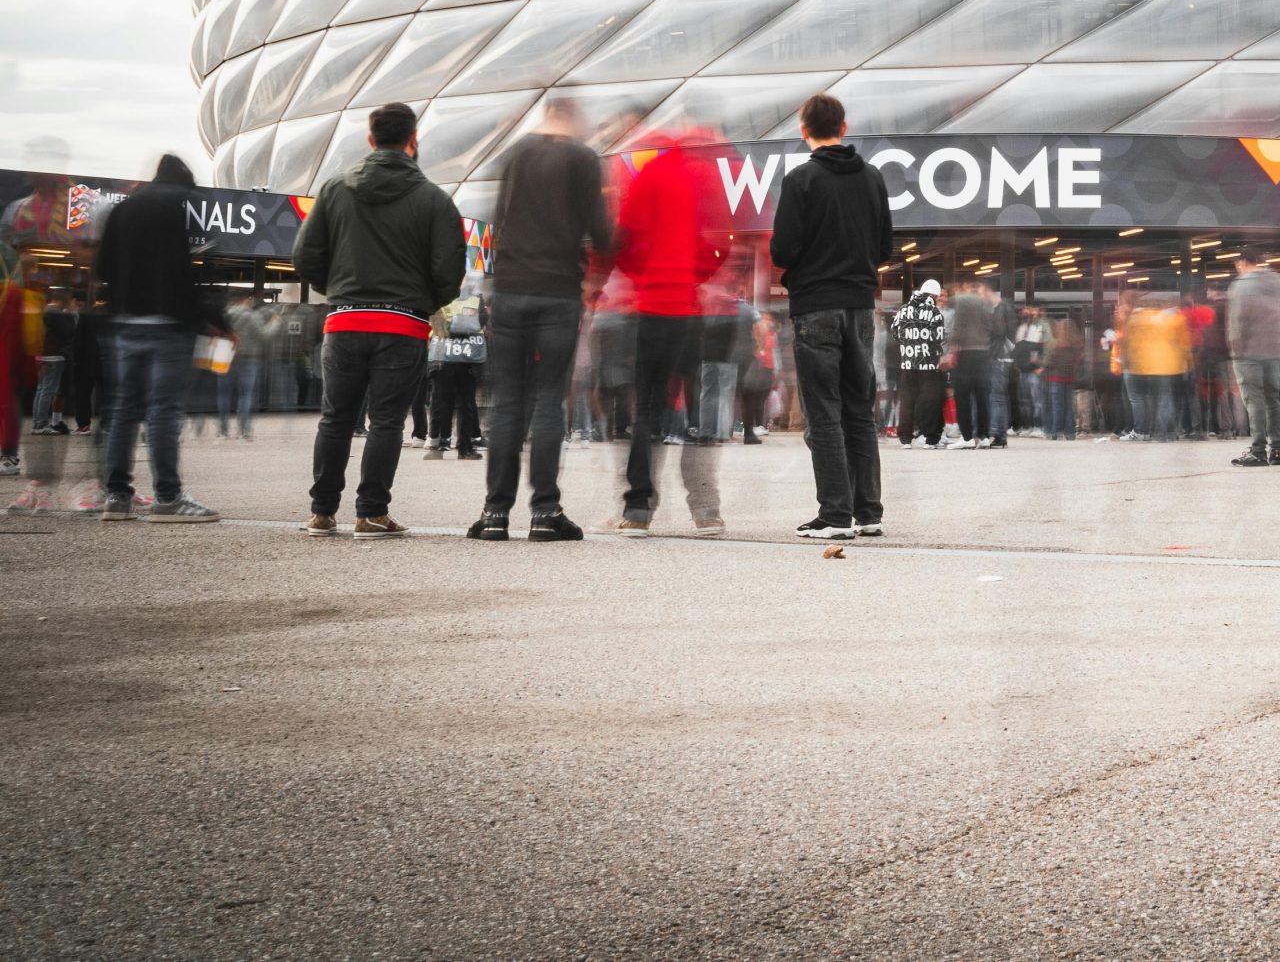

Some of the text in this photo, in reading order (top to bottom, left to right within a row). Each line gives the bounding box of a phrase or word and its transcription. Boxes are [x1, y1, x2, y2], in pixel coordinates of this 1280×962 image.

[716, 146, 1102, 216] WCOME
[106, 192, 131, 204] UEF
[184, 199, 257, 235] NALS
[188, 237, 206, 245] 025
[445, 342, 472, 357] 184
